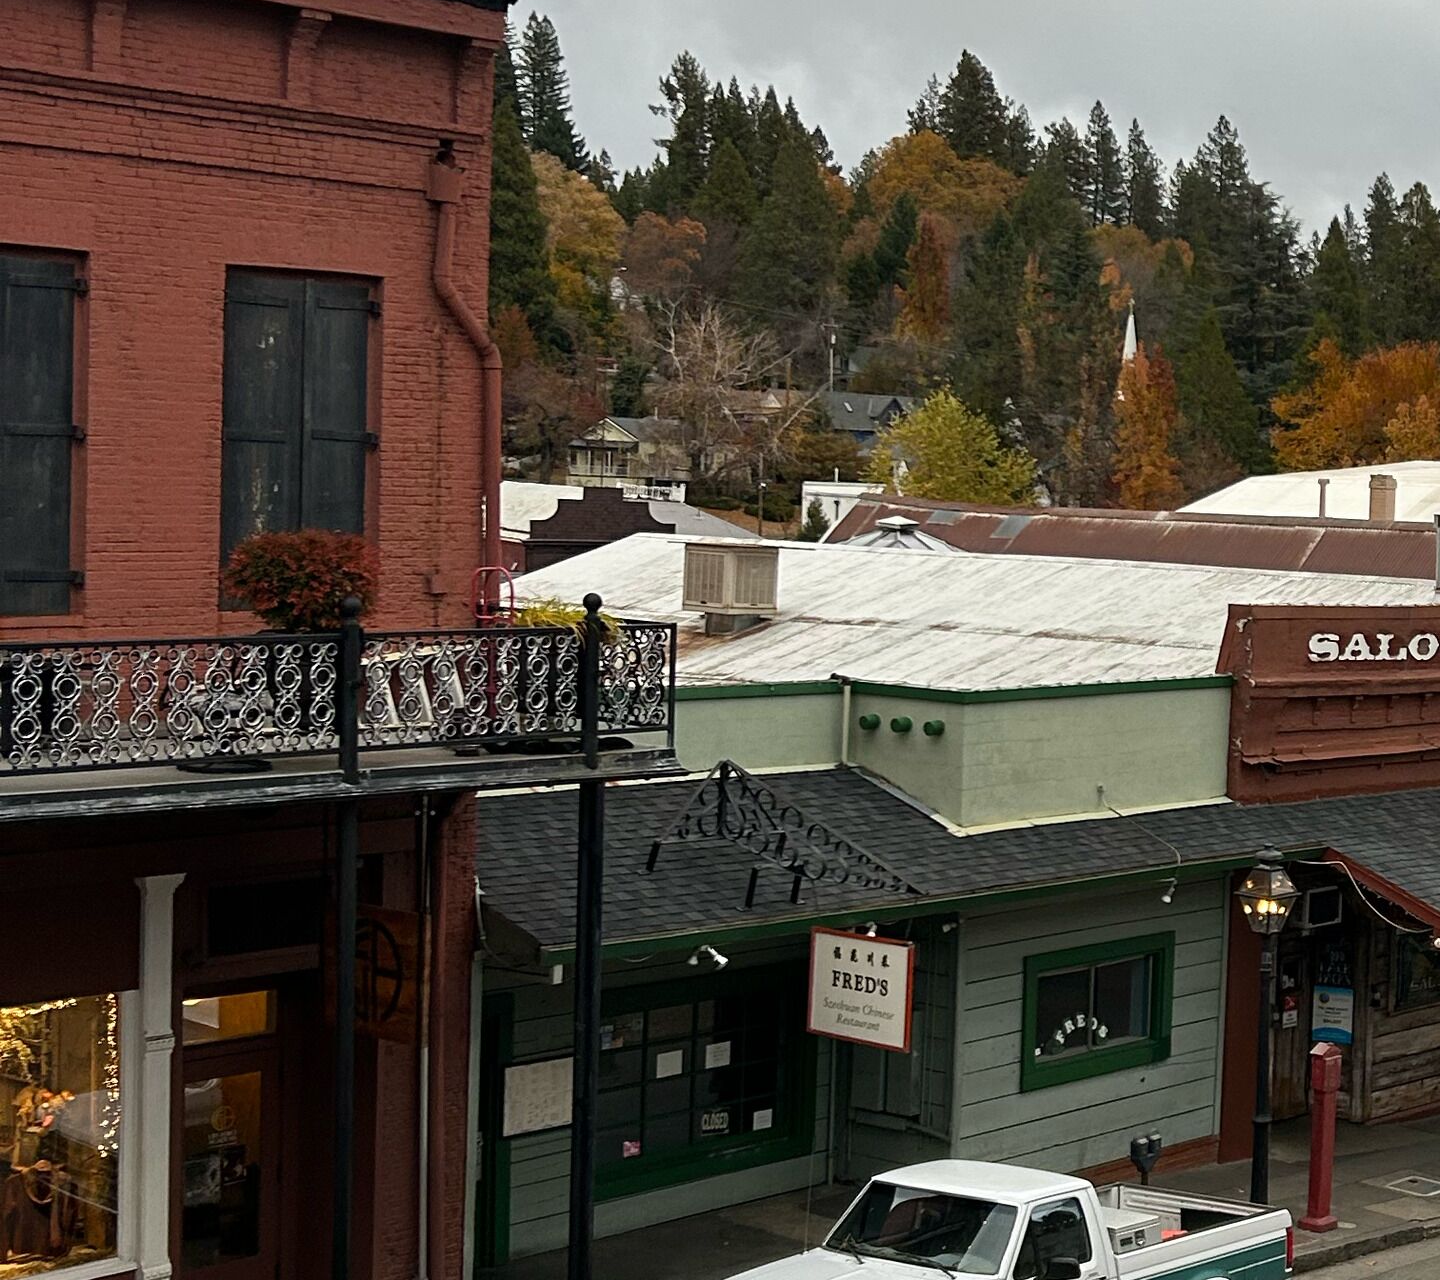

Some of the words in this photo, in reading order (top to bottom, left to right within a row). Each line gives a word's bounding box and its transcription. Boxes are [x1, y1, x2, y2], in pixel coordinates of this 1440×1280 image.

[831, 969, 889, 997] FRED'S
[835, 1012, 881, 1031] Restaurant
[702, 1111, 730, 1131] CLOSED
